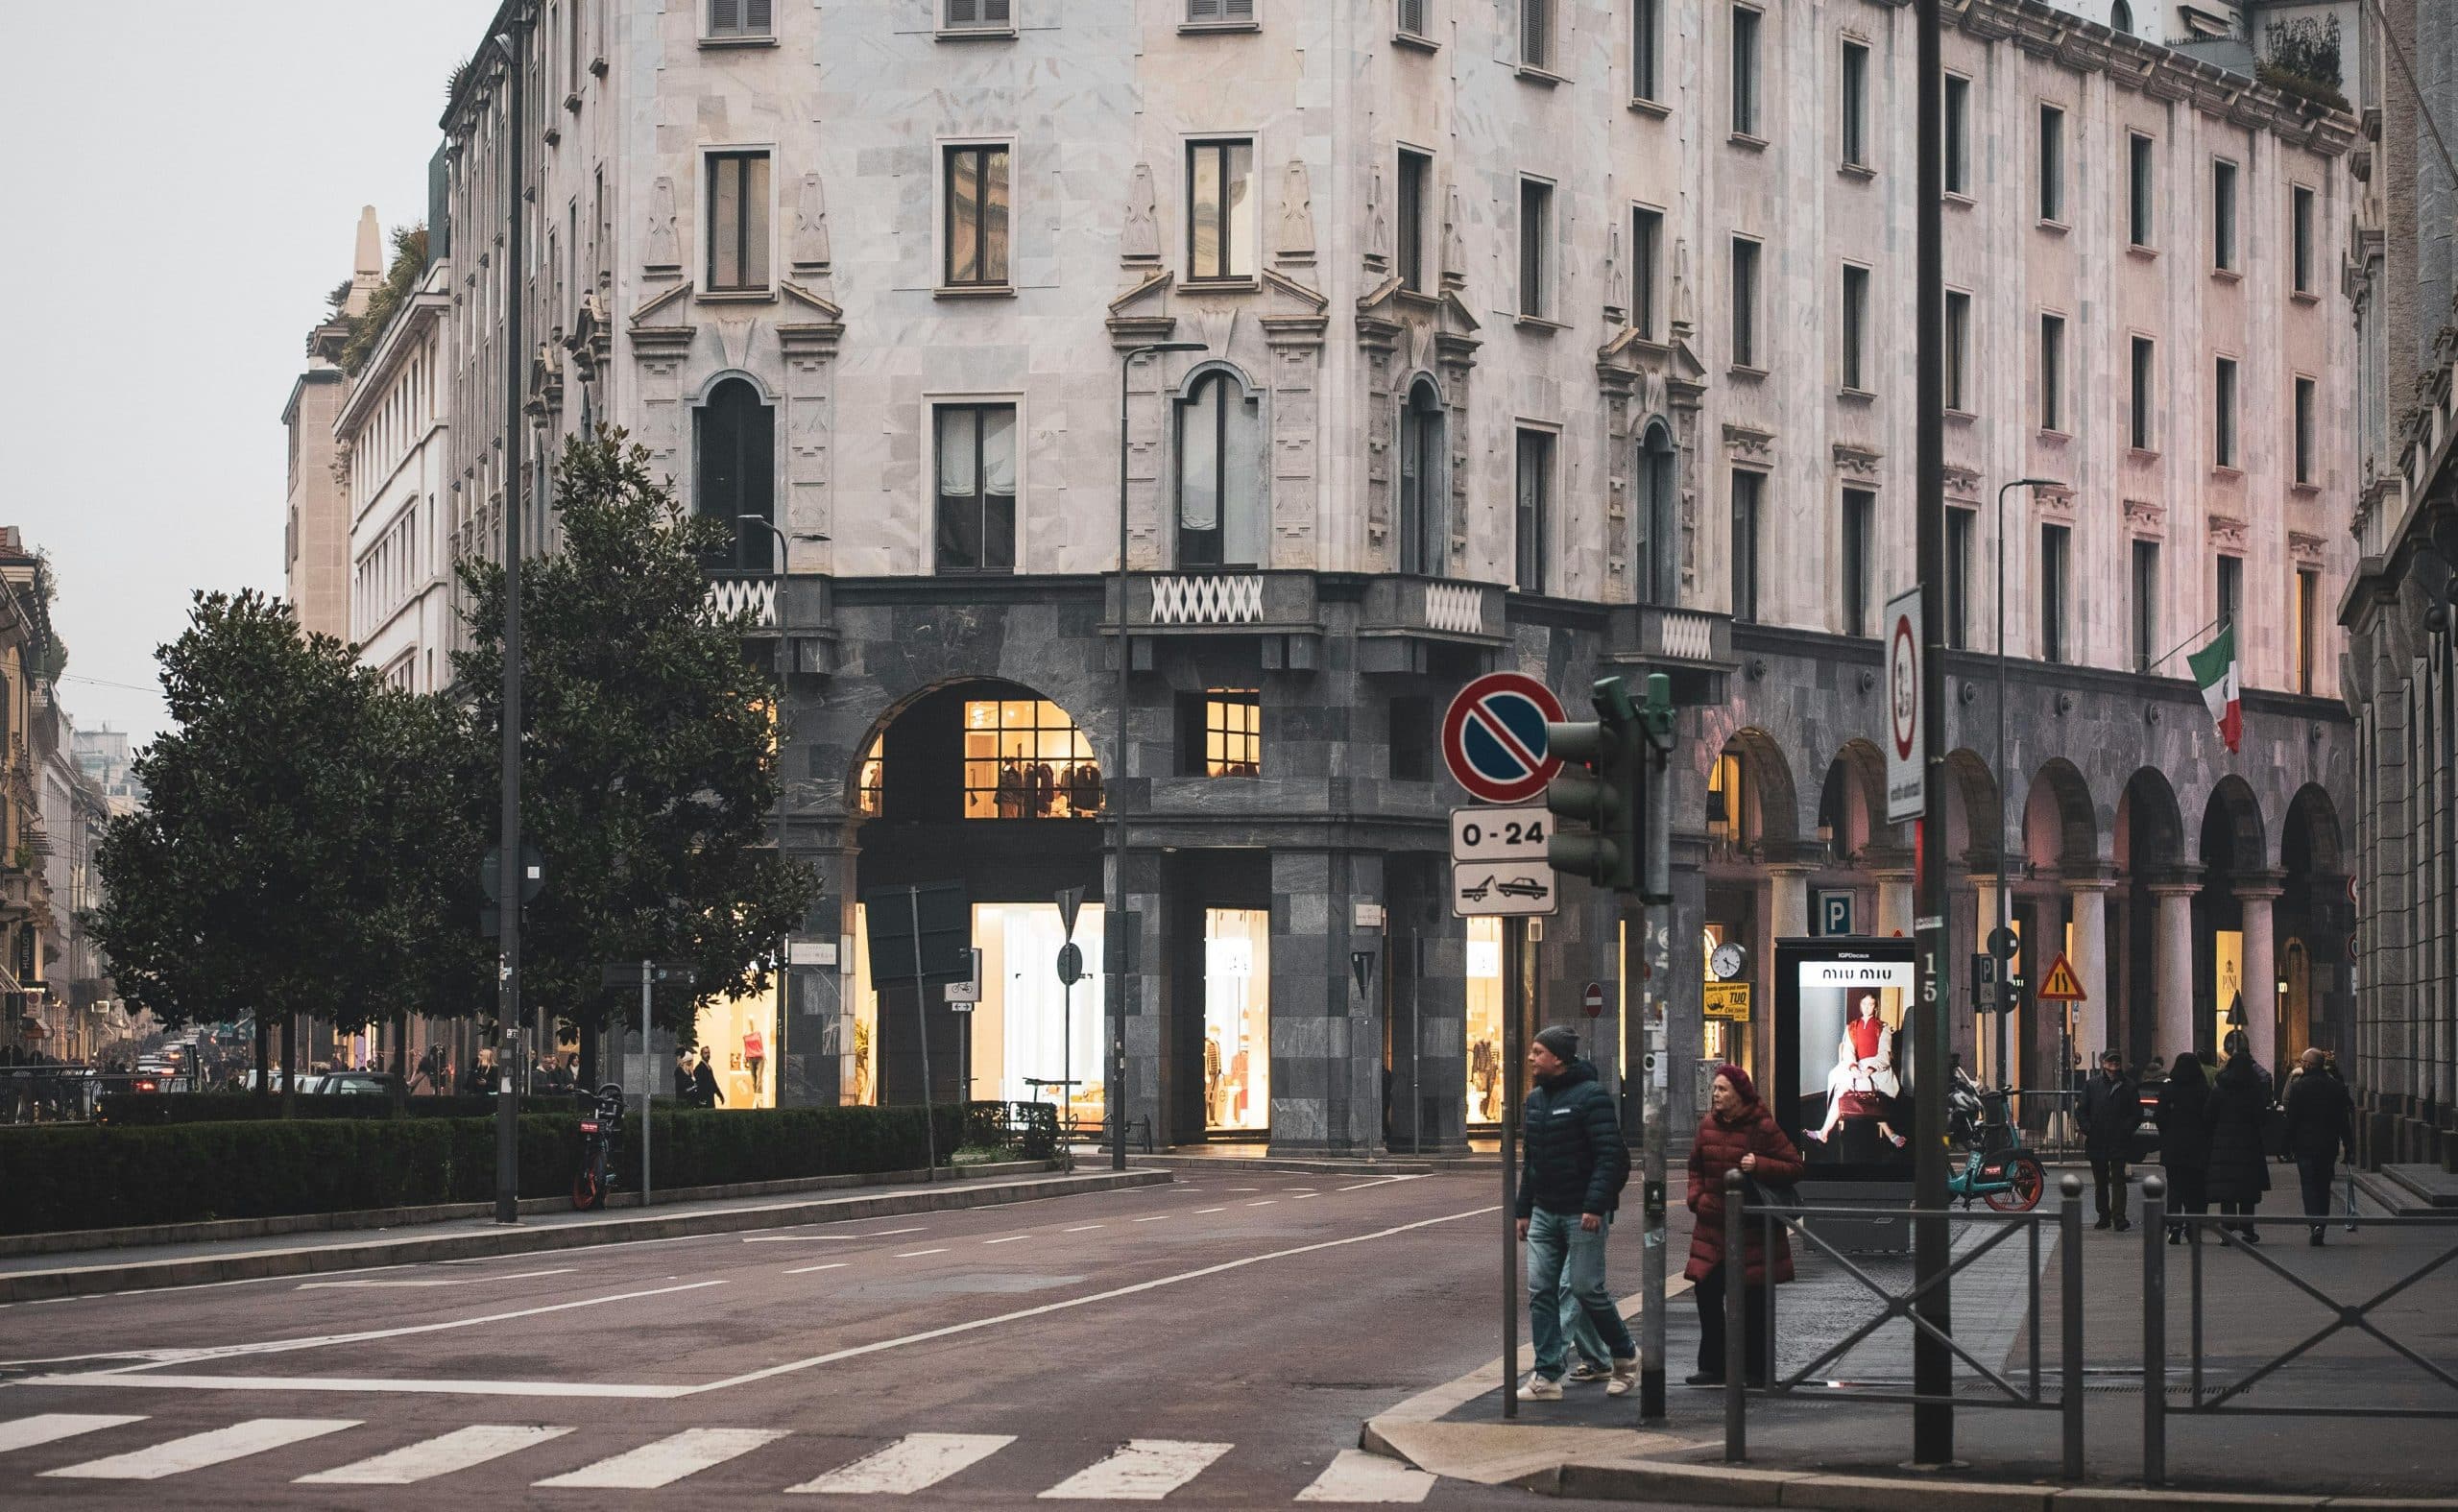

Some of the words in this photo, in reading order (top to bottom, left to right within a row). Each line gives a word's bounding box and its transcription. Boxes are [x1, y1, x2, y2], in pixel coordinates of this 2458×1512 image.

[1505, 821, 1545, 845] 24
[1830, 901, 1845, 930] P
[1729, 992, 1747, 1004] TUO
